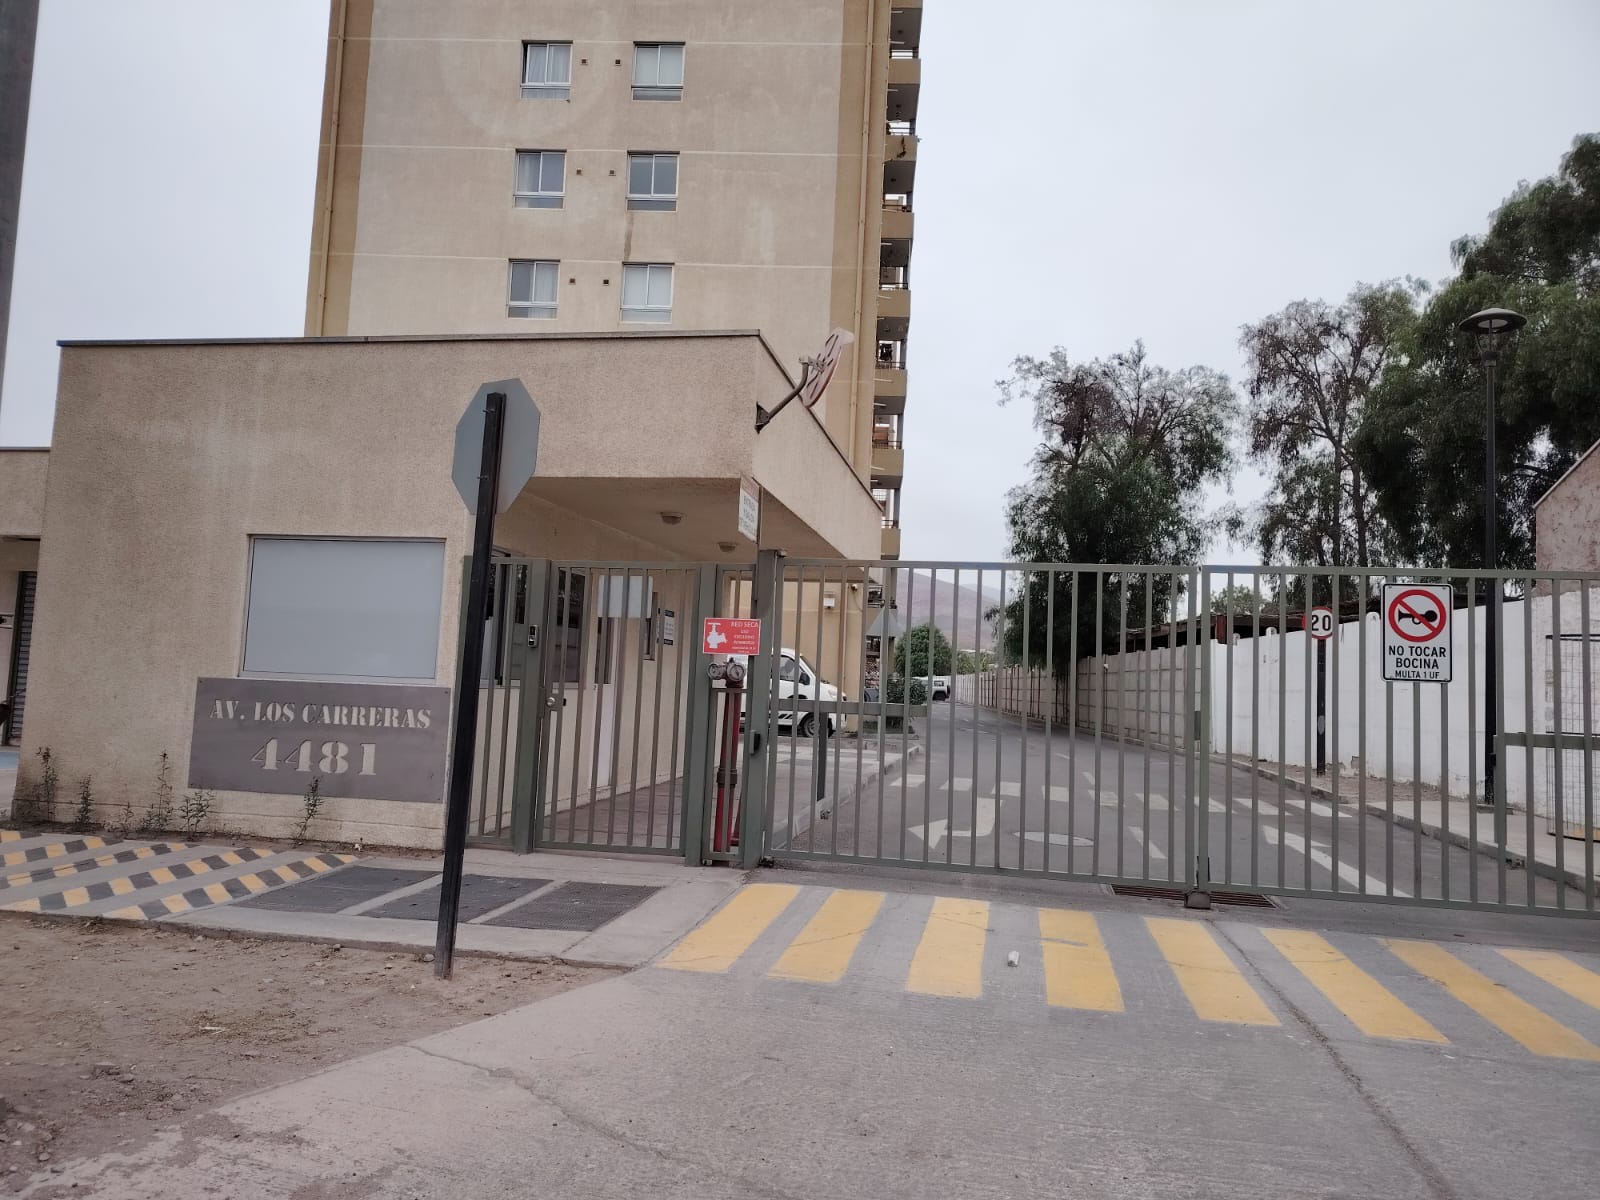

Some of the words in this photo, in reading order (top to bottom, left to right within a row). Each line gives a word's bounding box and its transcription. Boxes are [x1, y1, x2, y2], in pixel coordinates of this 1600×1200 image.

[1311, 614, 1331, 631] 20
[1388, 645, 1404, 656] NO
[1408, 645, 1446, 657] TOCAR
[1395, 657, 1439, 669] BOCINA
[1395, 670, 1420, 678] MULTA
[1429, 671, 1440, 679] UF
[210, 699, 245, 720] AV.
[254, 701, 296, 722] LOS
[302, 703, 432, 728] CARRERAS
[250, 737, 377, 776] 4481
